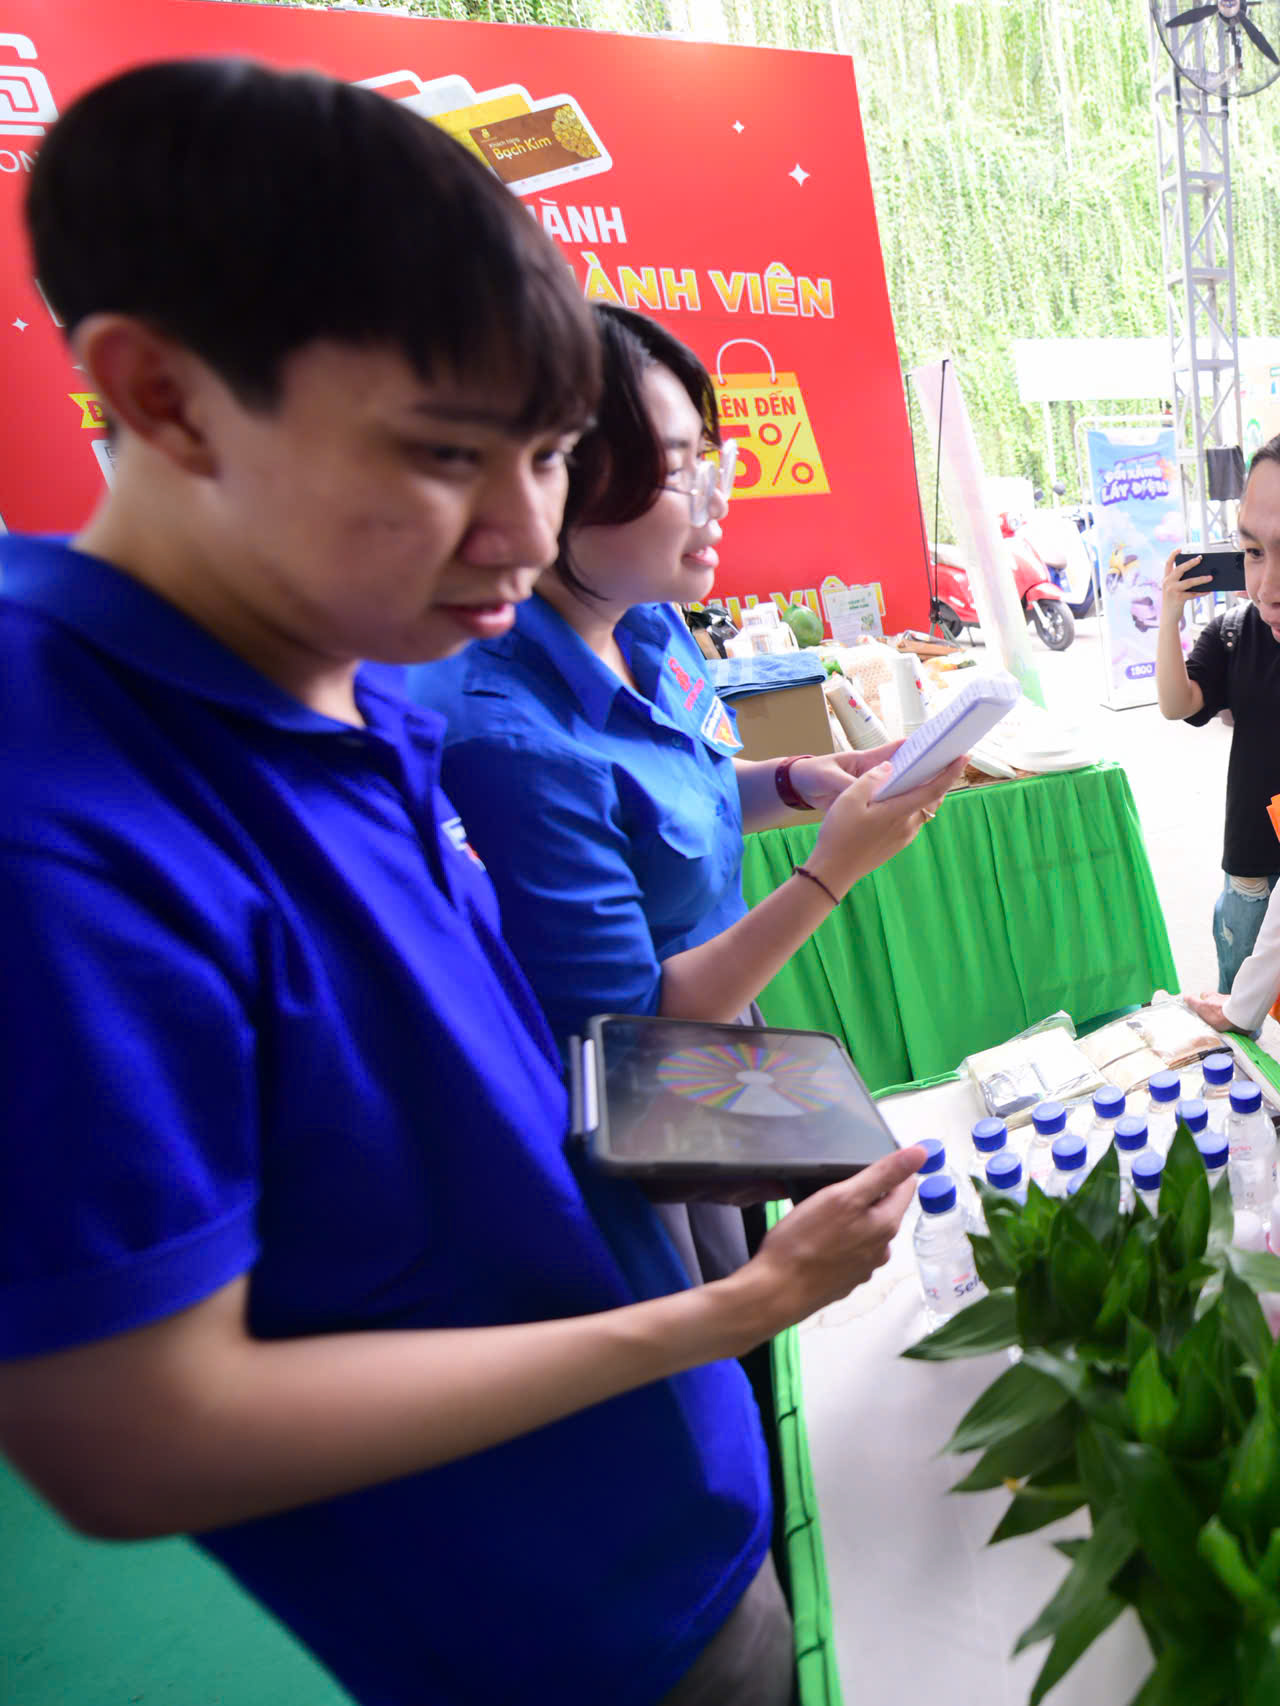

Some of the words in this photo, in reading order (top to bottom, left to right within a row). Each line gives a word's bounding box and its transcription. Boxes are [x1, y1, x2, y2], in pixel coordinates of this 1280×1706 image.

[492, 142, 527, 160] Bạch
[523, 137, 553, 151] Kim
[525, 197, 628, 243] ÀNH
[568, 251, 702, 311] ÀNH
[707, 262, 835, 319] VIÊN
[718, 393, 749, 418] ÊN
